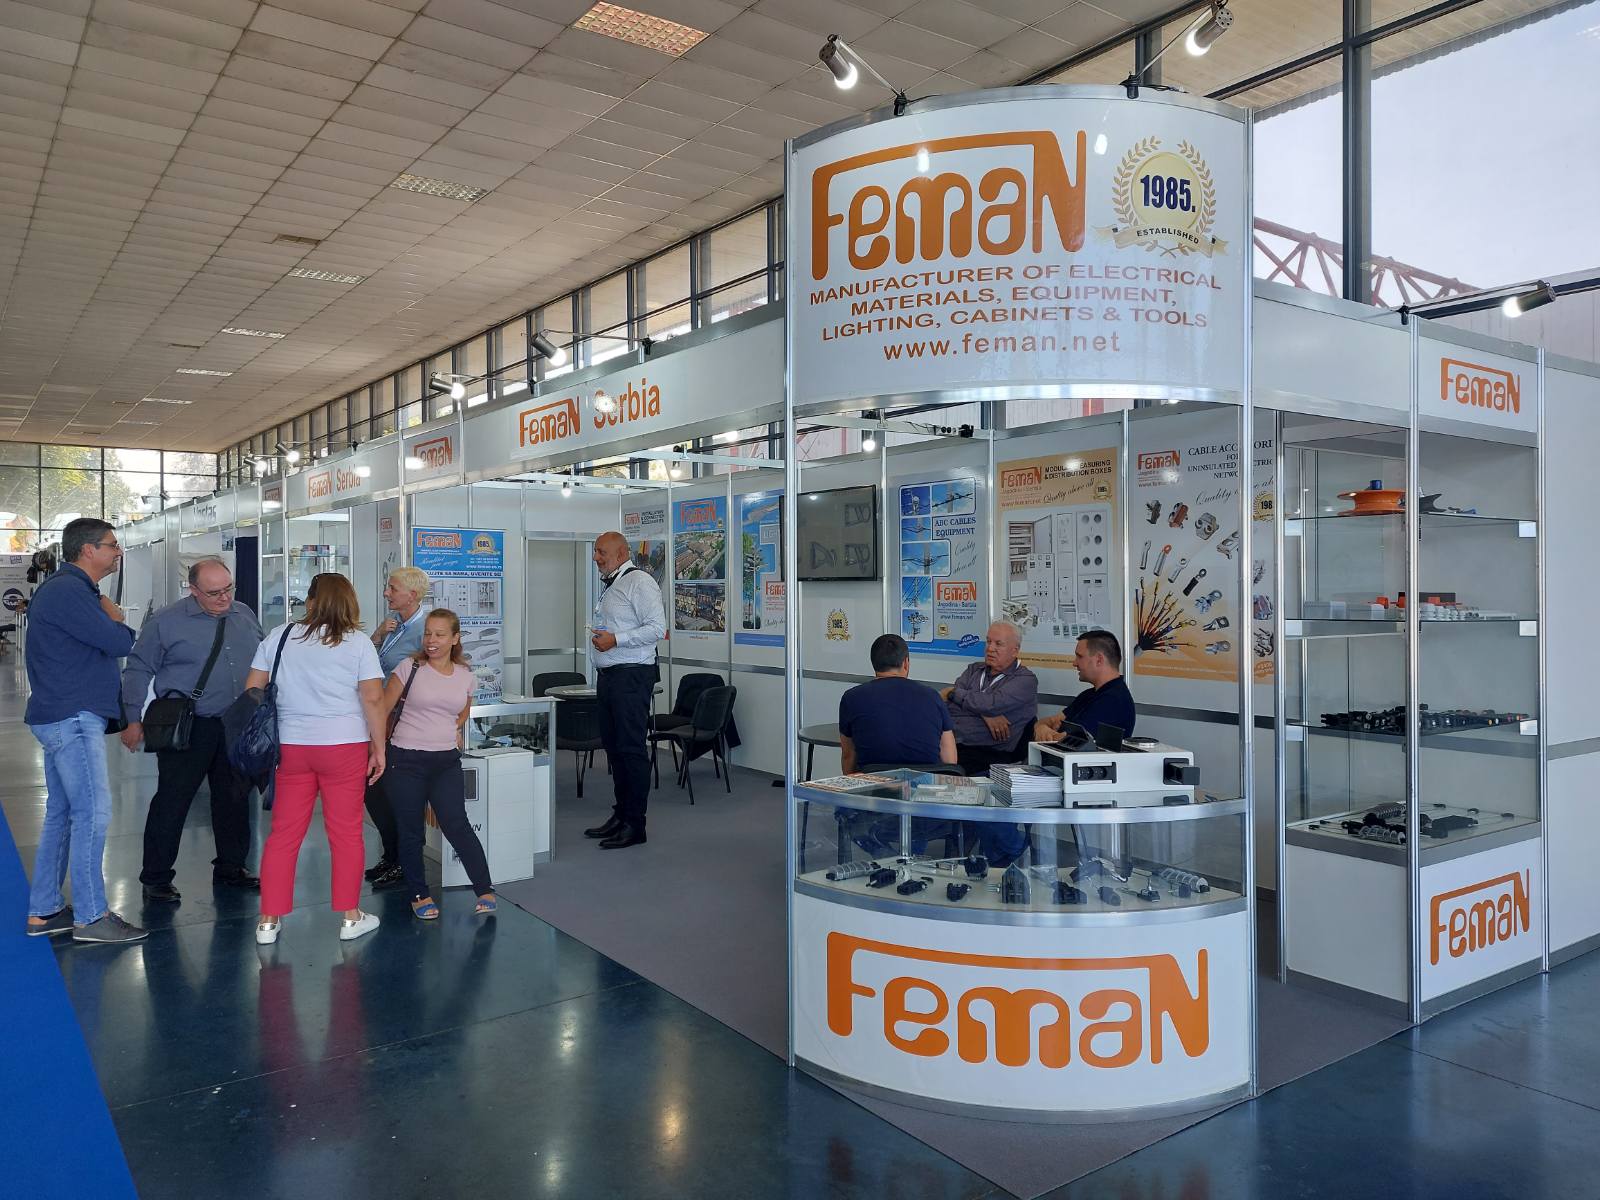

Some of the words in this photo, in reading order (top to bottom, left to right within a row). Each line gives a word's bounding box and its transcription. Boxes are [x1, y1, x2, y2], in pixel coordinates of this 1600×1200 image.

[1140, 174, 1196, 213] 1985.
[1136, 227, 1199, 244] ESTABLISHED
[810, 266, 1014, 305] MANUFACTURER
[1022, 265, 1061, 280] OF
[1069, 264, 1222, 290] ELECTRICAL
[851, 287, 1002, 316] MATERIALS,
[1012, 286, 1177, 307] EQUIPMENT,
[823, 313, 942, 341] LIGHTING,
[950, 306, 1095, 325] CABINETS
[1102, 306, 1121, 321] &
[1129, 307, 1208, 328] TOOLS
[883, 331, 1121, 361] www.feman.net
[1188, 445, 1217, 456] CABLE
[1090, 466, 1112, 475] BOXES
[1187, 461, 1237, 472] UNINSULATED
[934, 518, 949, 527] ABC
[949, 516, 977, 526] CABLES
[935, 527, 976, 537] EQUIPMENT
